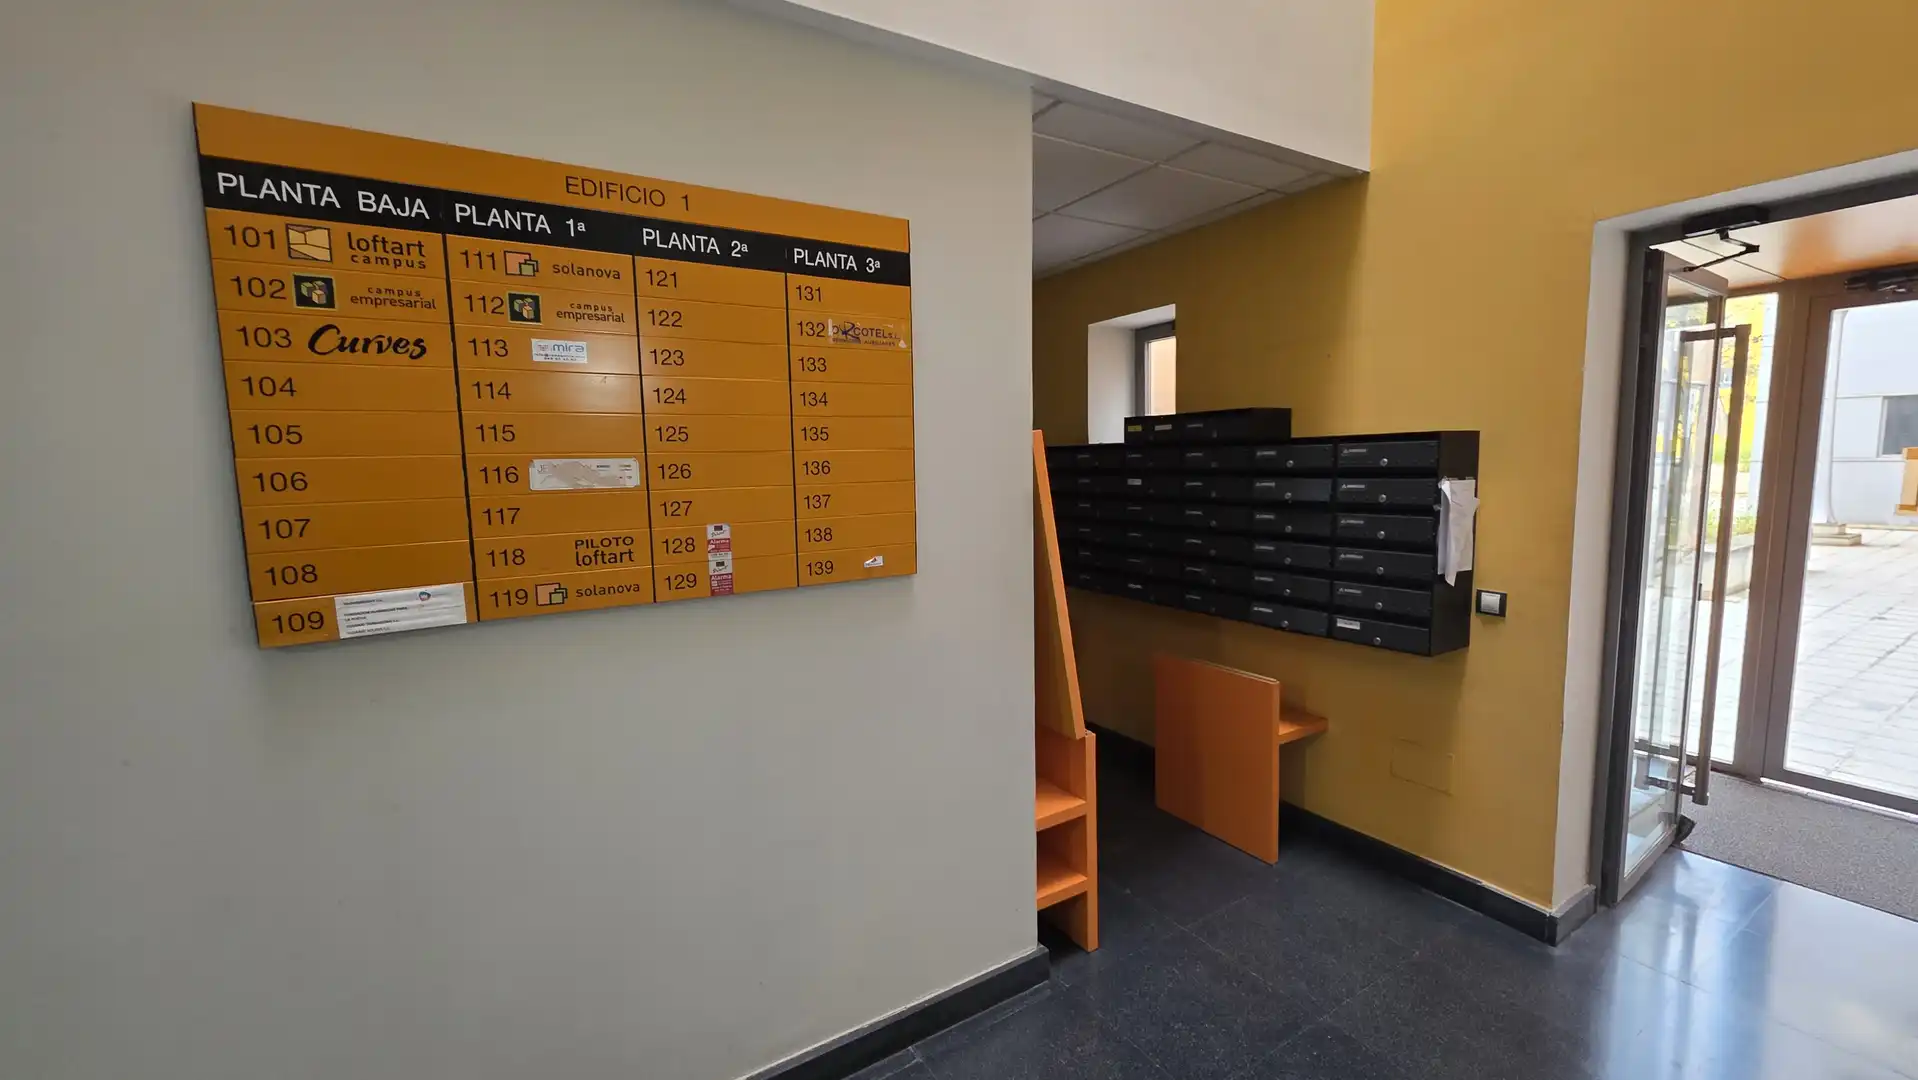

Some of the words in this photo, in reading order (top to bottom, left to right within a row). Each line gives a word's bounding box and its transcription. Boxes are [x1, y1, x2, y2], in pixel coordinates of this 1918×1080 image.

[217, 172, 341, 209] PLANTA
[357, 190, 429, 220] BAJA
[565, 175, 666, 207] EDIFICIO
[681, 194, 690, 211] 1
[454, 203, 552, 234] PLANTA
[223, 224, 277, 250] 101
[347, 231, 425, 257] loftart
[642, 228, 720, 255] PLANTA
[351, 253, 427, 270] campus
[459, 249, 497, 271] 111
[793, 248, 858, 271] PLANTA
[552, 262, 621, 280] solanova
[645, 269, 678, 289] 121
[230, 275, 287, 300] 102
[367, 286, 421, 299] campus
[795, 284, 823, 302] 131
[349, 294, 437, 310] empresarial
[464, 294, 505, 315] 112
[569, 301, 613, 313] campus
[555, 310, 626, 324] empresarial
[647, 309, 683, 328] 122
[236, 326, 292, 349] 103
[796, 320, 826, 338] 132
[307, 323, 427, 360] Curves
[468, 337, 509, 358] 113
[650, 348, 685, 367] 123
[797, 356, 827, 373] 133
[241, 375, 297, 397] 104
[472, 380, 512, 400] 114
[652, 386, 687, 405] 124
[799, 391, 828, 407] 134
[247, 423, 303, 445] 105
[475, 423, 516, 443] 115
[655, 425, 689, 442] 125
[801, 425, 829, 442] 135
[479, 465, 519, 484] 116
[657, 463, 692, 480] 126
[802, 460, 831, 476] 136
[252, 471, 308, 492] 106
[659, 500, 693, 518] 127
[803, 494, 831, 510] 137
[482, 507, 521, 526] 117
[258, 518, 311, 540] 107
[804, 527, 833, 543] 138
[574, 536, 635, 550] PILOTO
[661, 536, 696, 555] 128
[486, 548, 526, 567] 118
[574, 549, 635, 567] loftart
[264, 563, 318, 587] 108
[805, 560, 834, 577] 139
[575, 582, 641, 598] solanova
[664, 573, 697, 591] 129
[489, 588, 529, 608] 119
[271, 610, 325, 634] 109
